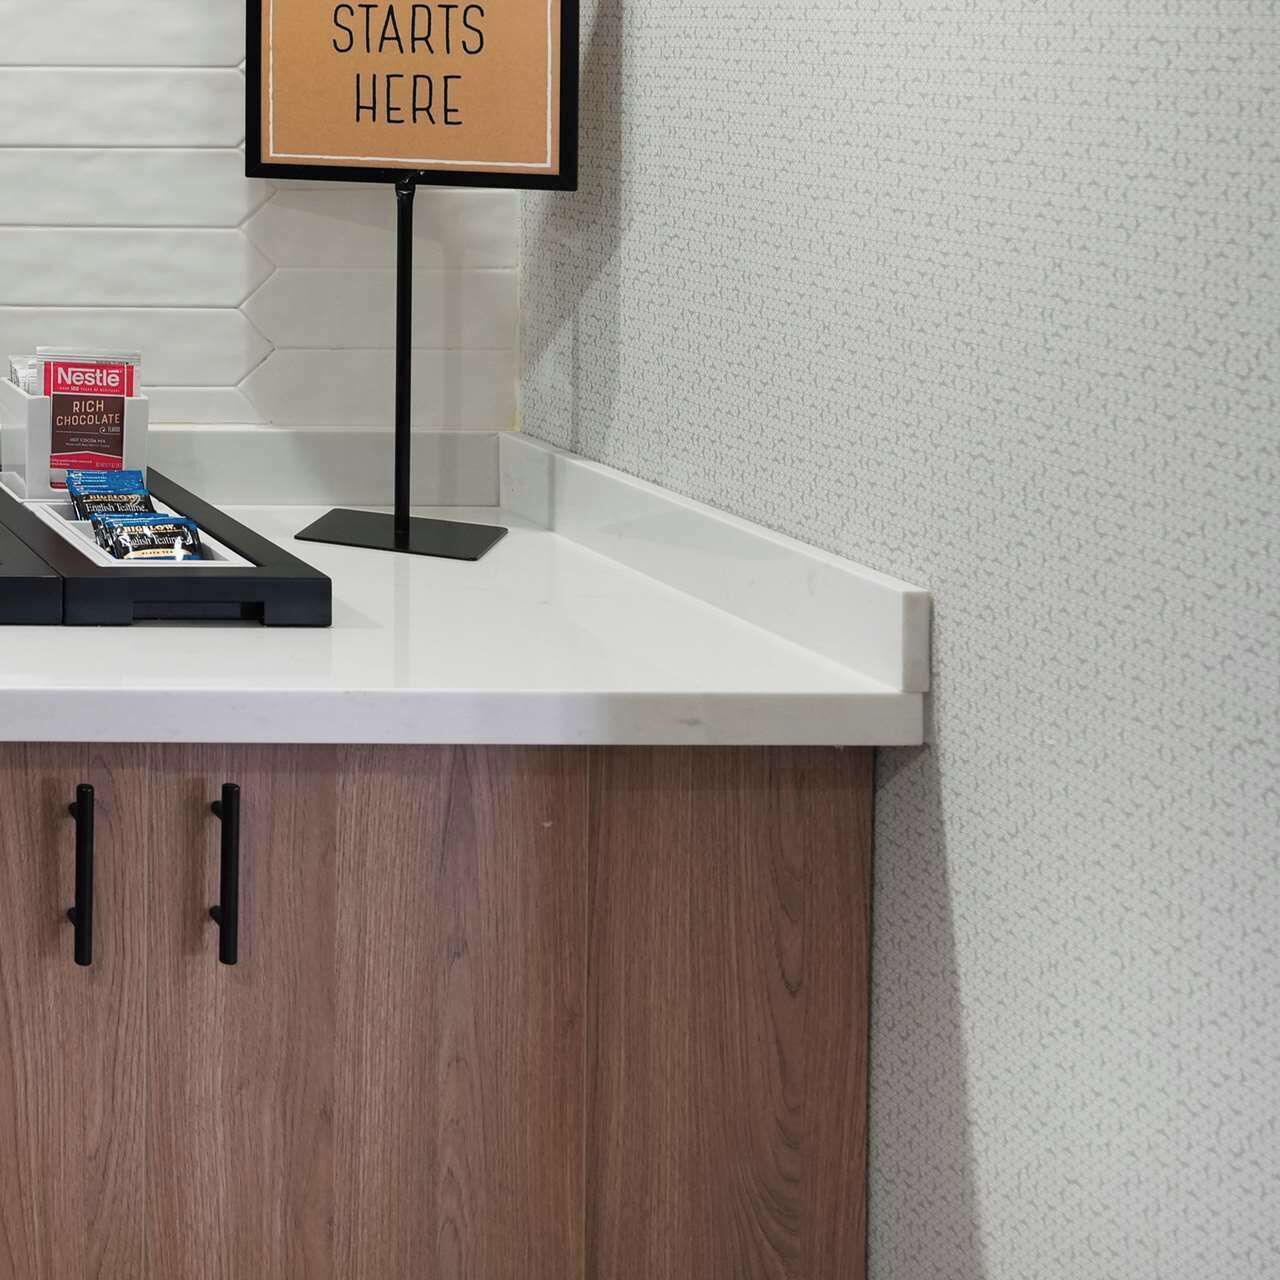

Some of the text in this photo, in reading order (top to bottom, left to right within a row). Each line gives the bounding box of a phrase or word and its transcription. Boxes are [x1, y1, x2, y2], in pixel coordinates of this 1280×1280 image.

[332, 3, 485, 55] STARTS
[355, 73, 463, 126] HERE
[73, 400, 104, 413] RICH
[56, 413, 120, 426] CHOCOLATE
[85, 503, 115, 513] English
